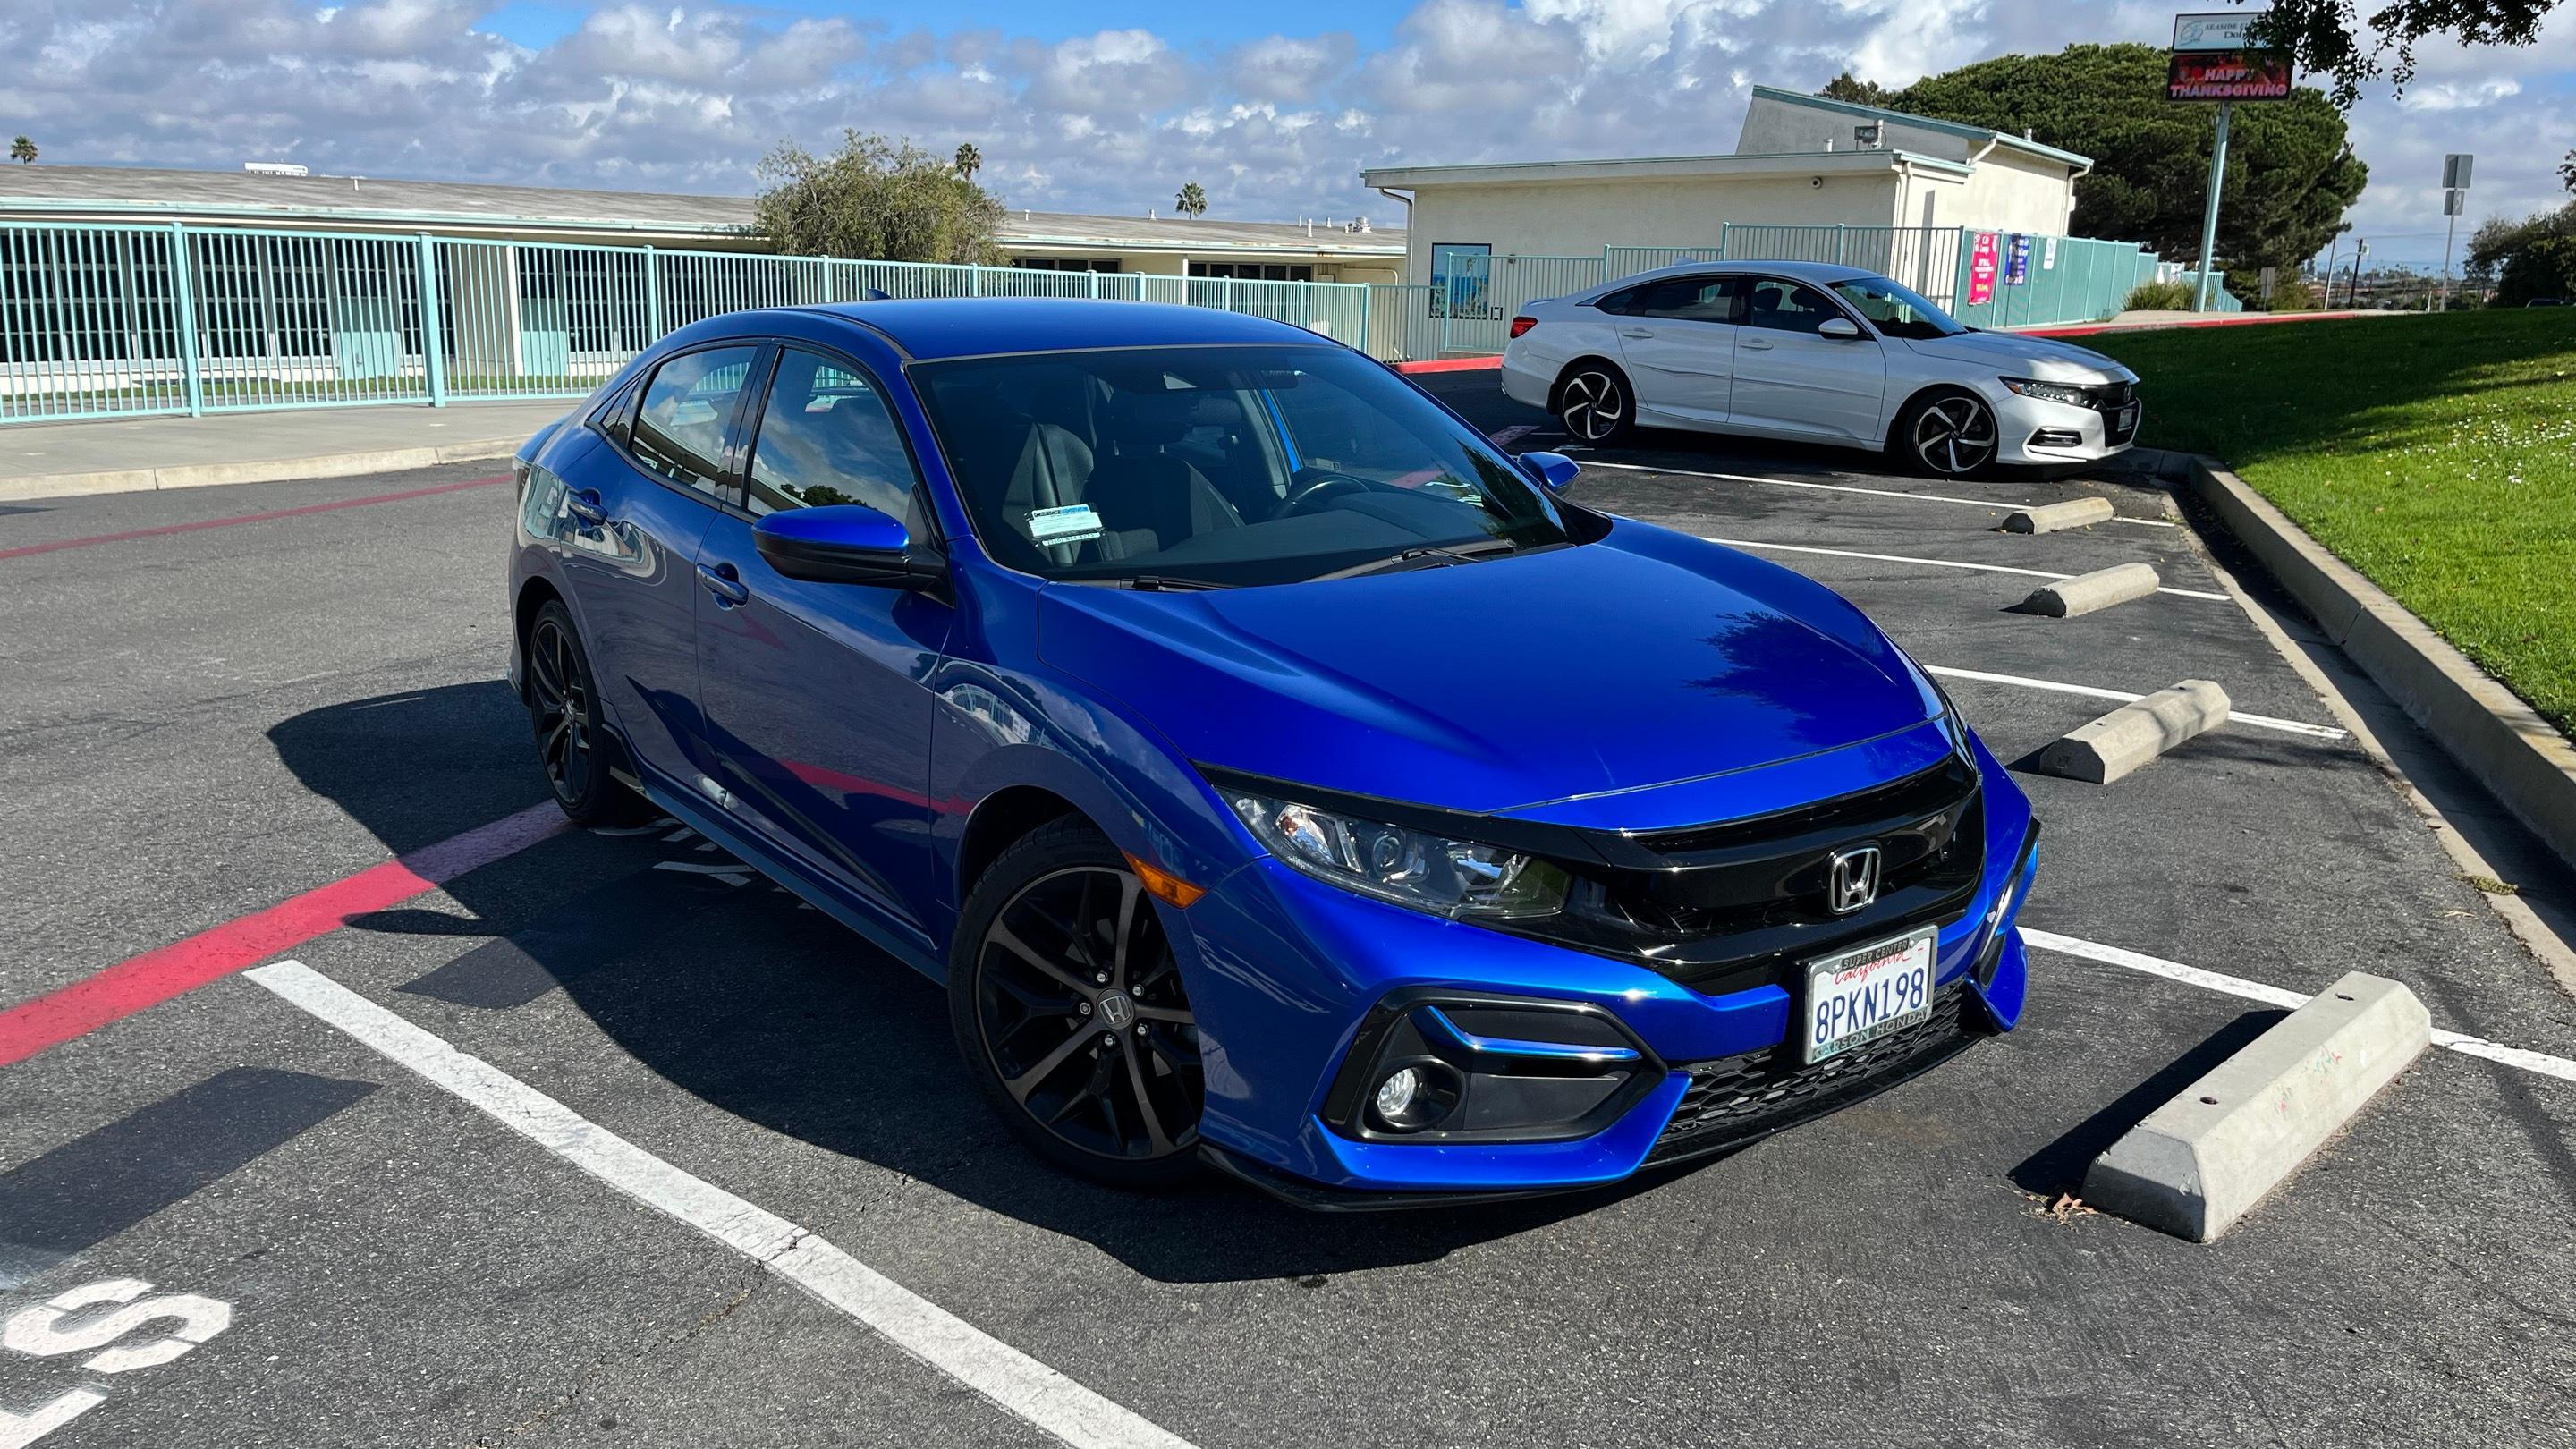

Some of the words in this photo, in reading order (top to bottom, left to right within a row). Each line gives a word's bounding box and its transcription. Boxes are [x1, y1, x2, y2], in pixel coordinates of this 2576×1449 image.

[2170, 83, 2288, 98] THANKSGIVING
[1842, 951, 1874, 970] SUPER
[1874, 939, 1909, 961] CENTER
[1815, 967, 1925, 1045] 8PKN198
[1814, 1027, 1871, 1060] CARSON
[1875, 1010, 1927, 1038] HONDA
